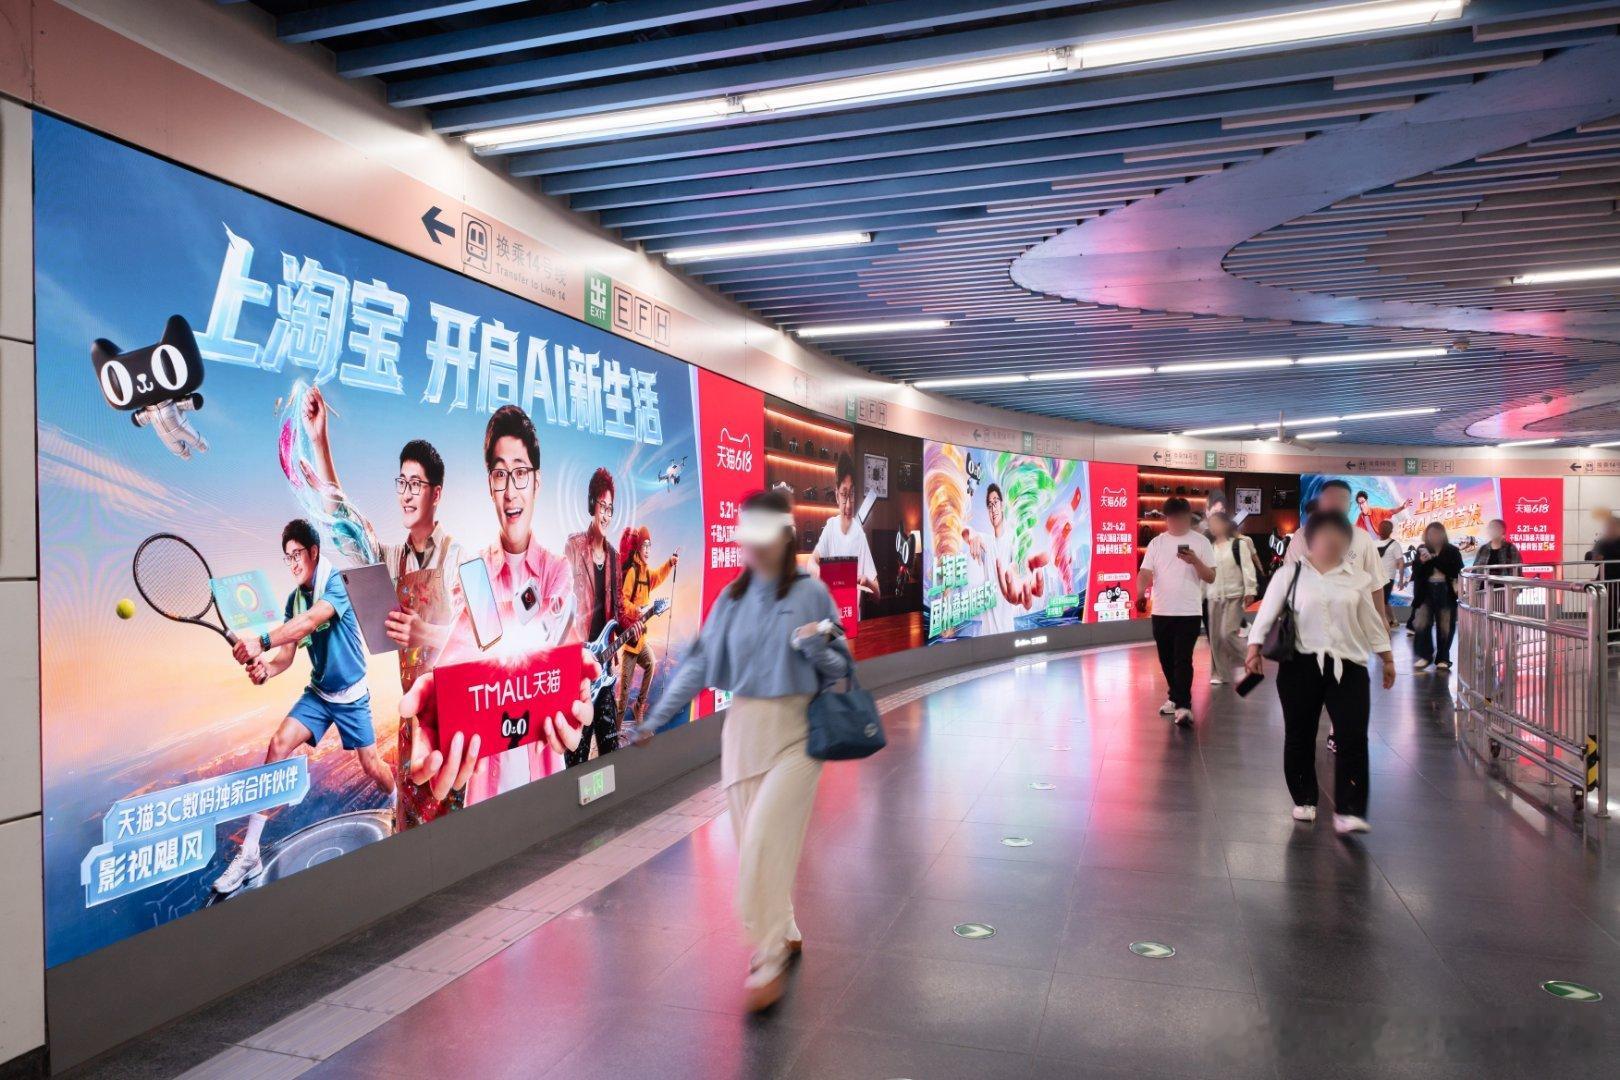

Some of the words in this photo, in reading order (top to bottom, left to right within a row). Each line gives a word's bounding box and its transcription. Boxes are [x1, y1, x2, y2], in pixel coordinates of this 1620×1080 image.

[540, 282, 556, 298] Line
[558, 290, 566, 301] 14
[590, 277, 607, 310] 出
[590, 305, 607, 321] EXIT
[618, 294, 628, 325] E
[639, 303, 648, 331] F
[657, 311, 667, 339] H
[194, 221, 410, 394] 上淘宝
[420, 300, 664, 446] 开启AI新生活
[716, 445, 753, 473] 天猫618
[1515, 504, 1549, 514] 天猫618
[1517, 525, 1547, 533] 5.21-6.21
[117, 765, 299, 840] 天猫3C数码独家合作伙伴
[97, 830, 204, 895] 影视飓风
